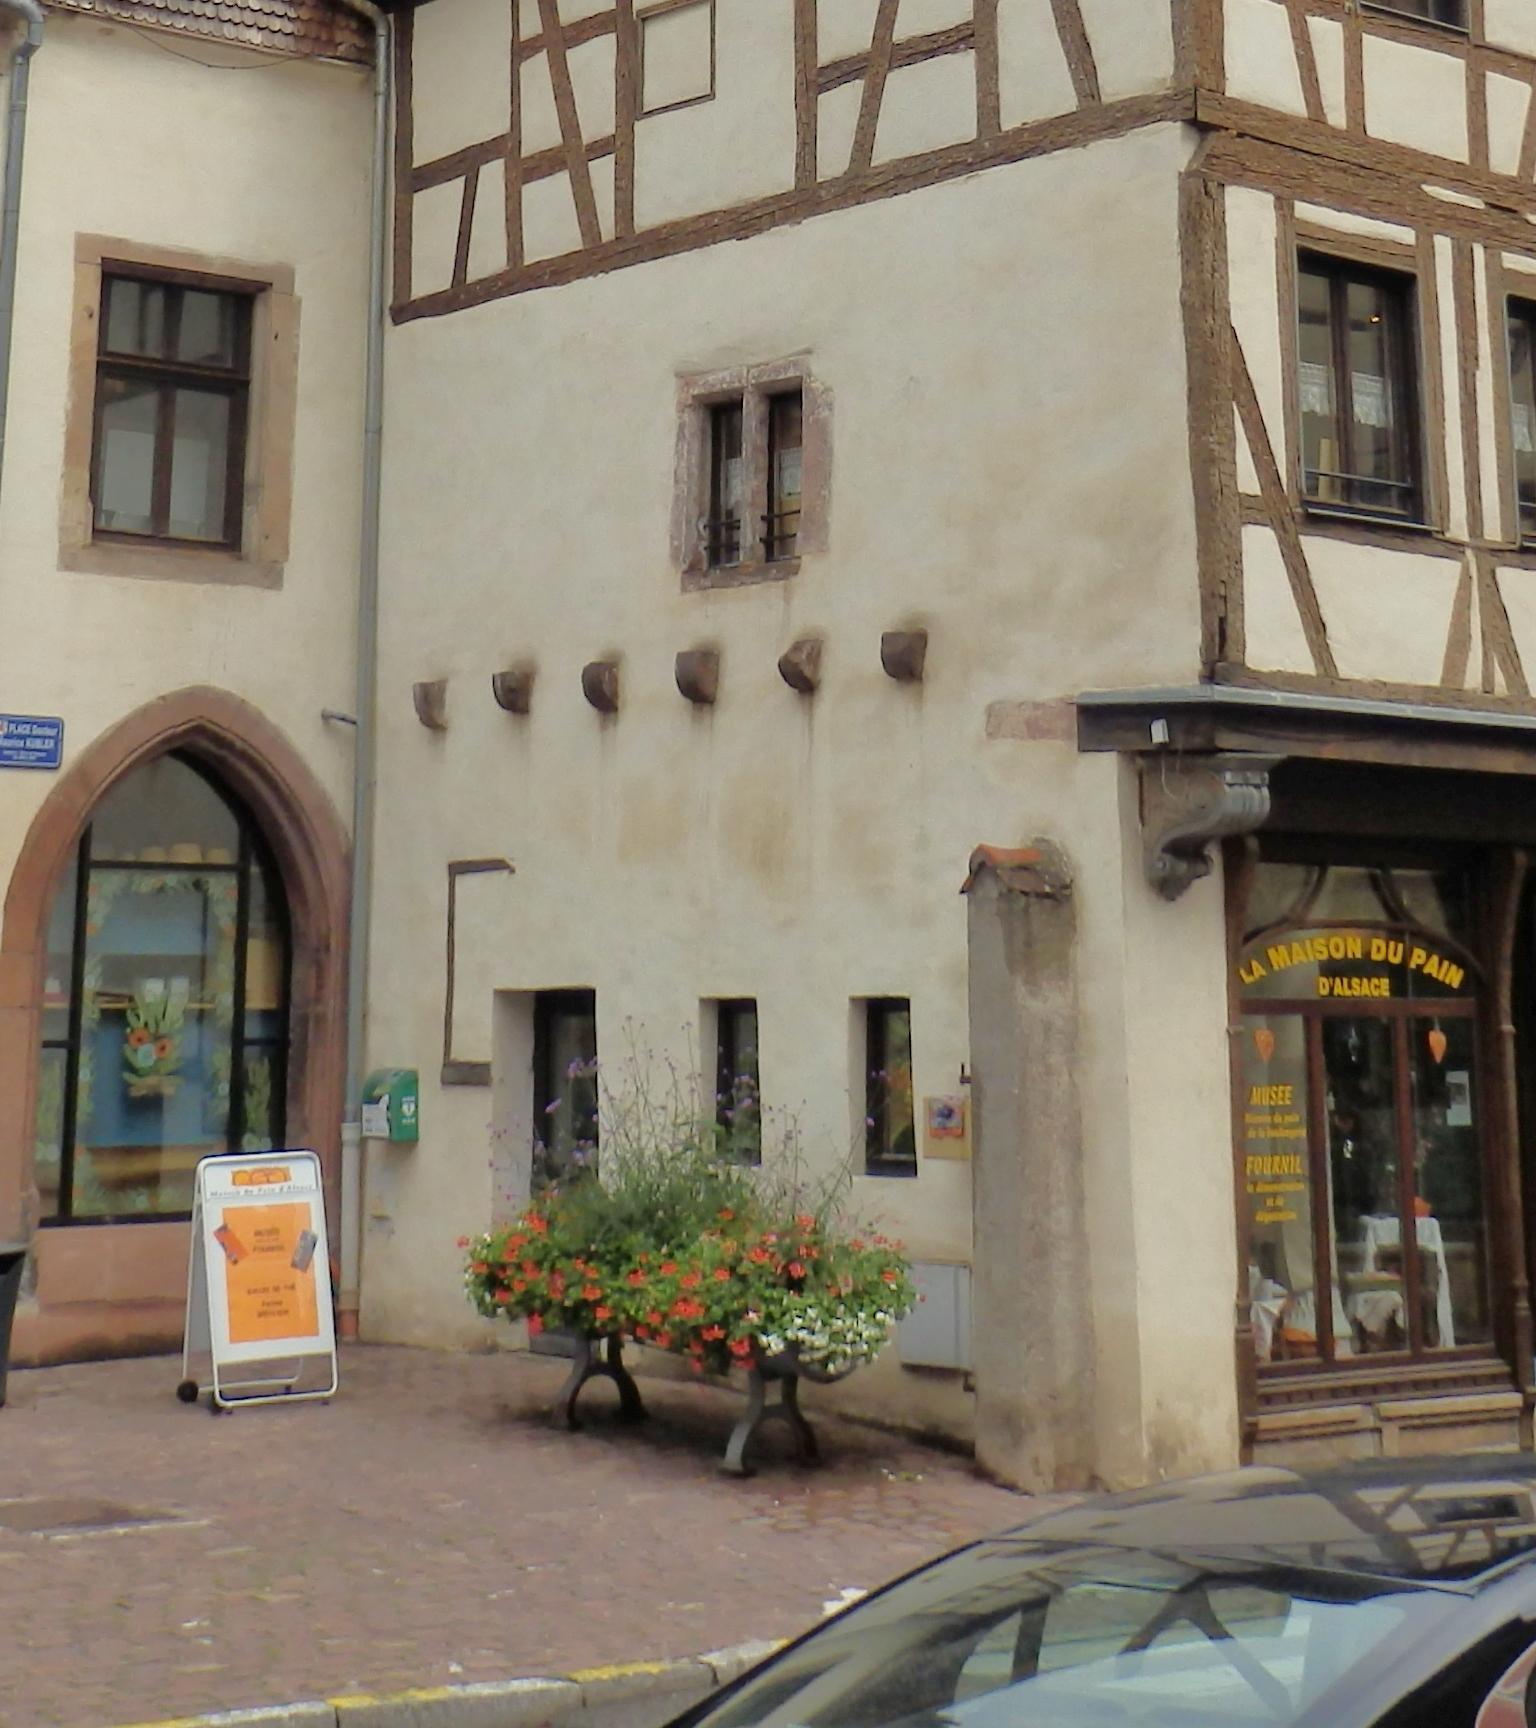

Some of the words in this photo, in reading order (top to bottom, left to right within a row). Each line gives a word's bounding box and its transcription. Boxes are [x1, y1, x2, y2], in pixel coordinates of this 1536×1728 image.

[9, 723, 31, 735] PLACE
[1239, 959, 1267, 985] LA
[1267, 936, 1362, 971] MAISON
[1370, 938, 1404, 965] DU
[1409, 946, 1464, 990] PAIN
[1318, 976, 1391, 997] D'ALSACE
[1246, 1155, 1303, 1176] FOURNIL
